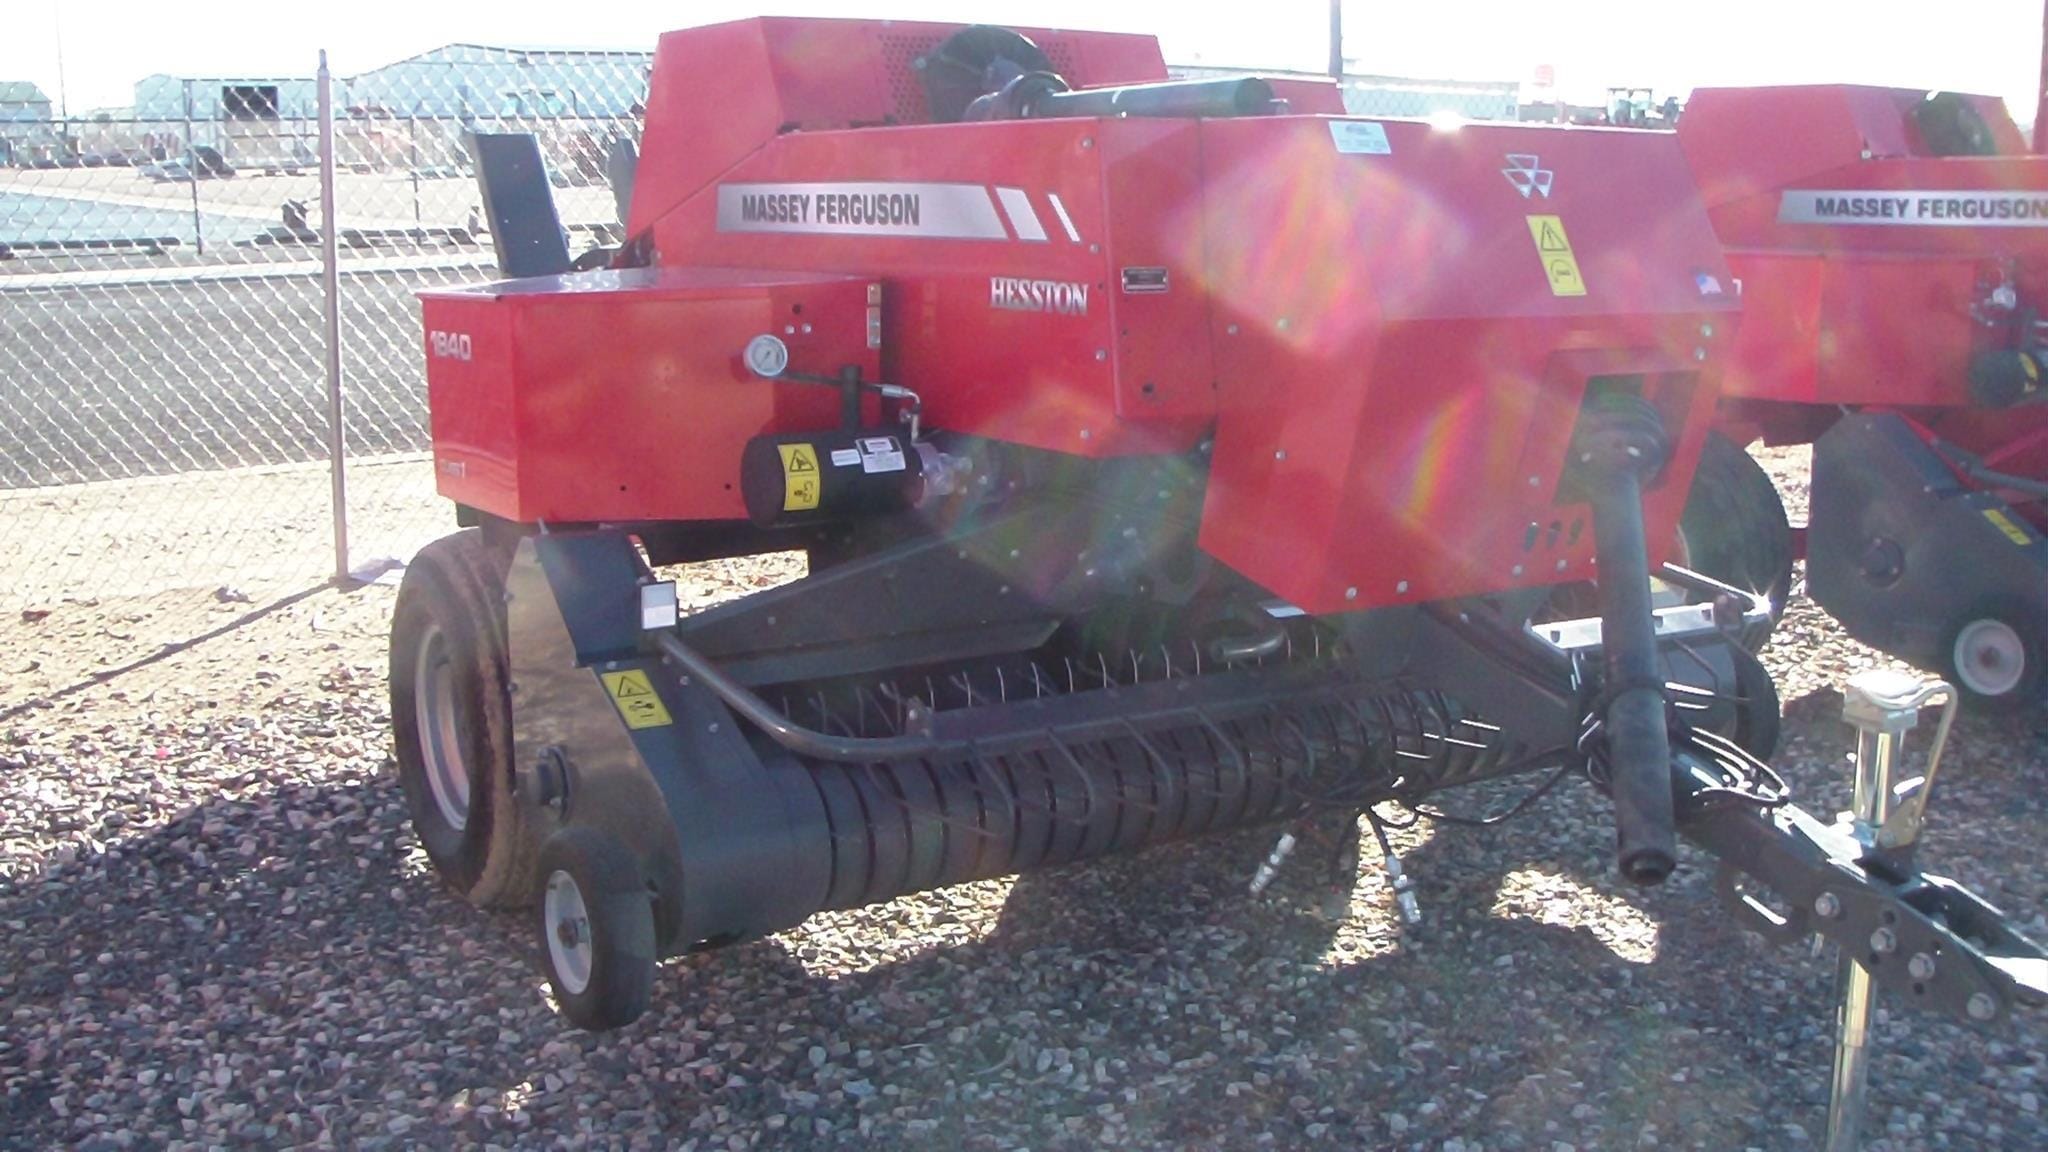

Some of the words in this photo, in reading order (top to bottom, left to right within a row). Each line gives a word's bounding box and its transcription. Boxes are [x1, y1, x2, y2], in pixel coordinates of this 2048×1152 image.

[742, 194, 810, 223] MASSEY
[816, 193, 920, 226] FERGUSON
[1815, 197, 1909, 217] MASSEY
[1917, 198, 2048, 219] FERGUSON
[991, 277, 1088, 315] HESSTON
[430, 330, 472, 361] 1840
